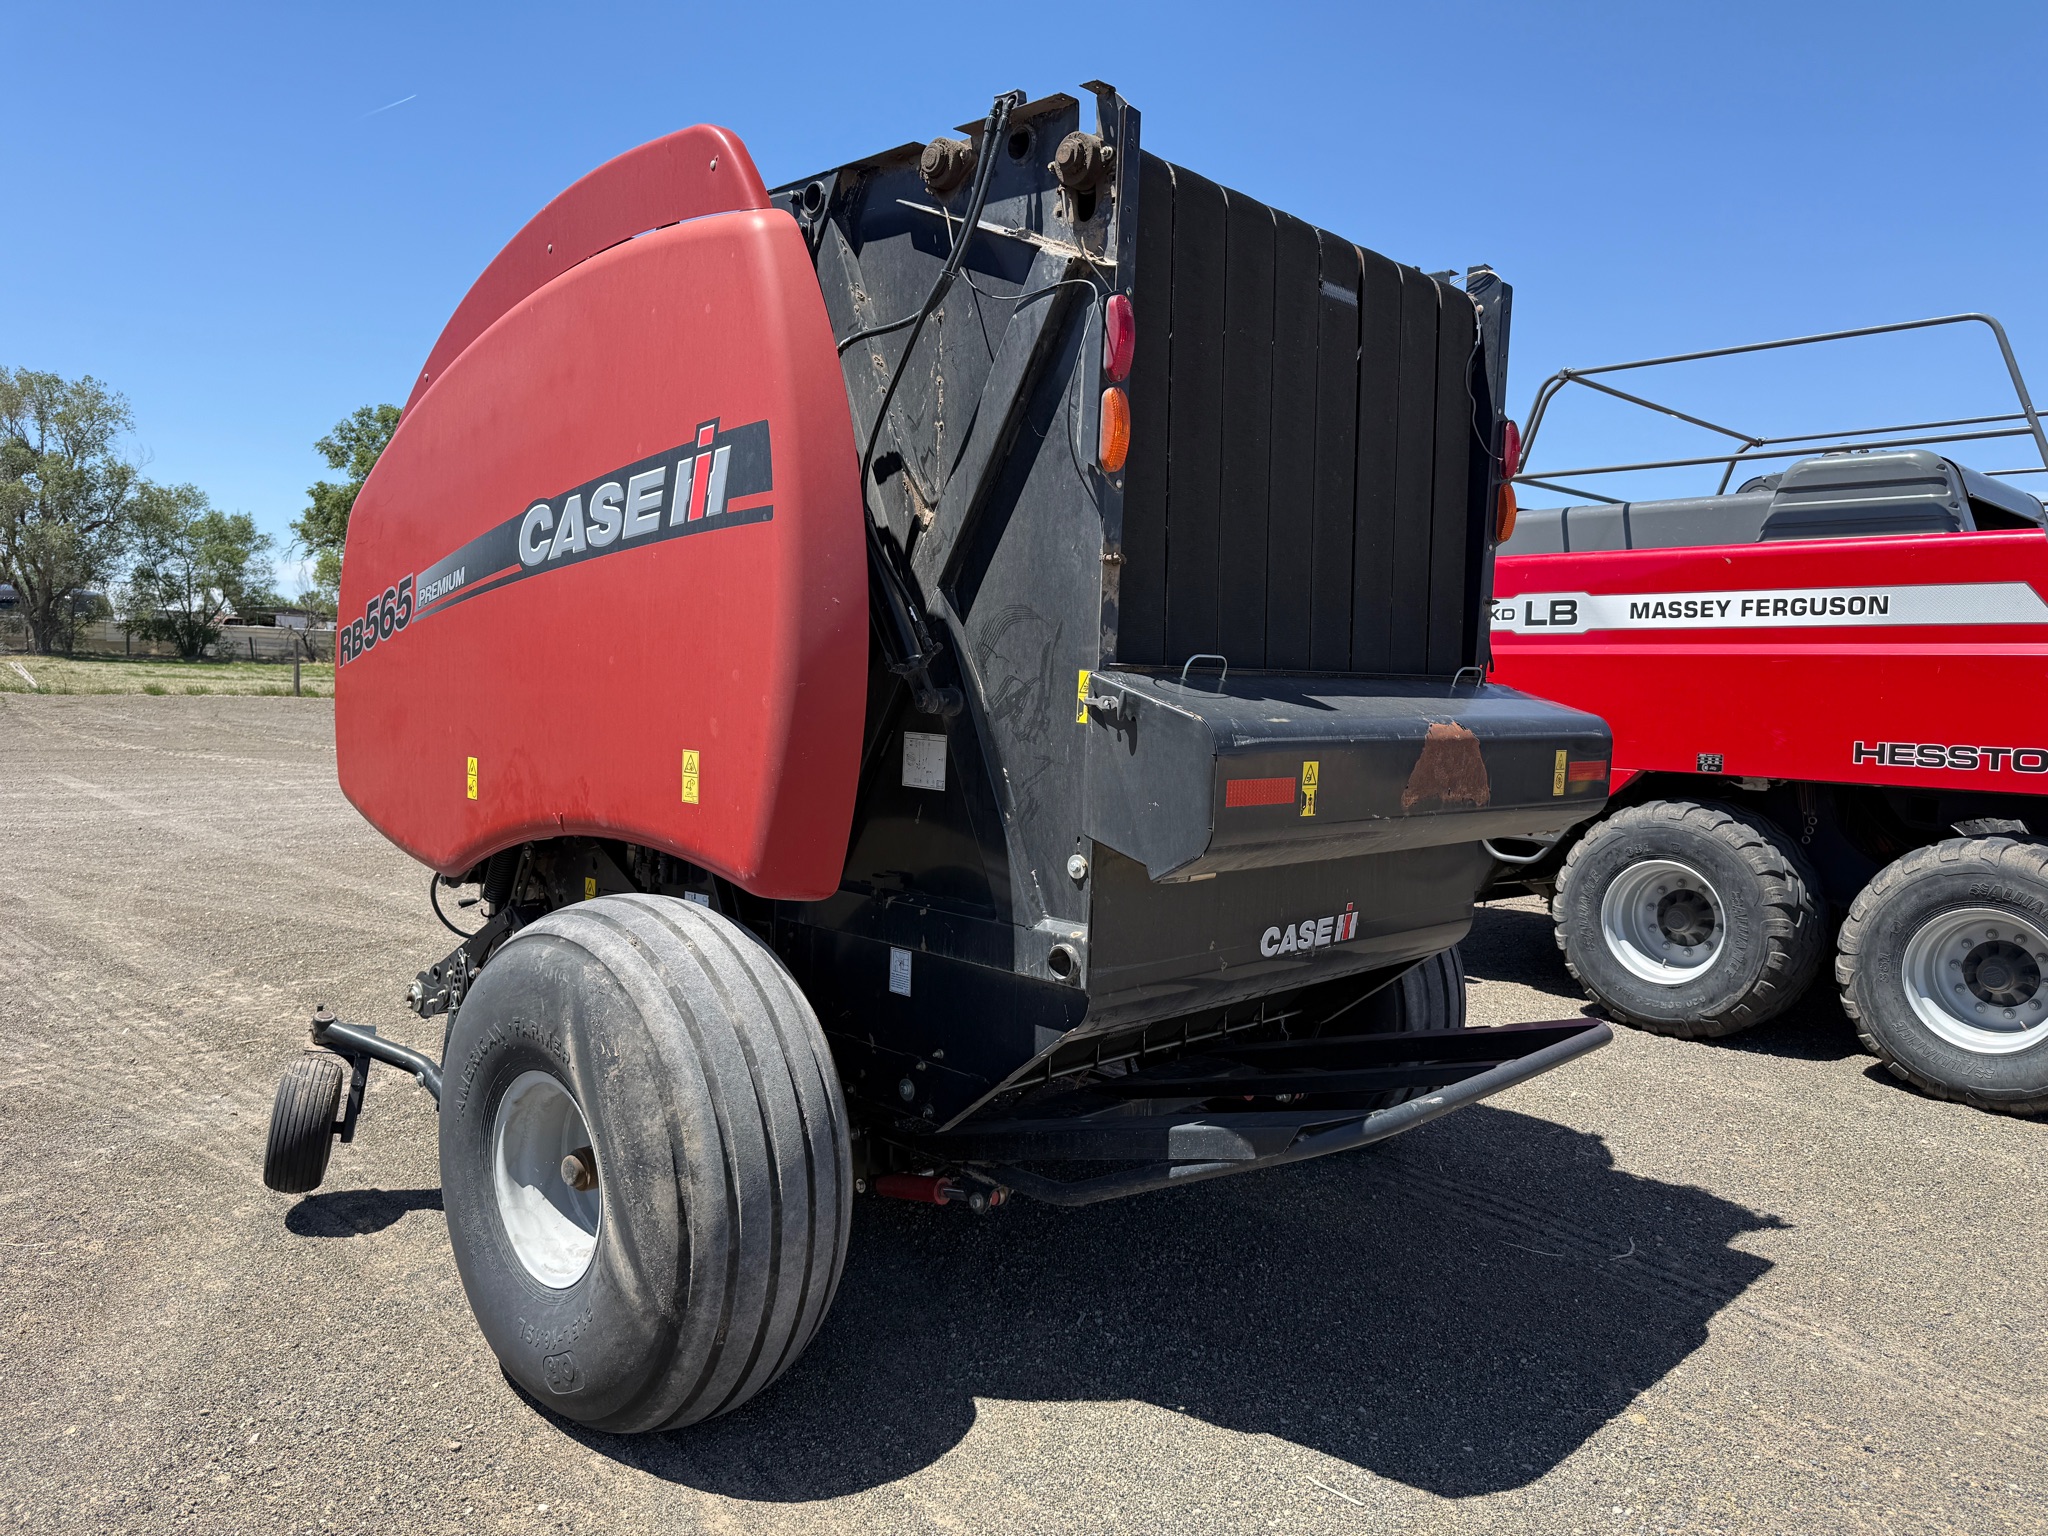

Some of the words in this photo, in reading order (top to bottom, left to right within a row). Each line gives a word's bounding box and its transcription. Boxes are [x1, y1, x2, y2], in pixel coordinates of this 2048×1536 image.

[519, 466, 666, 567] CASE
[418, 567, 465, 607] PREMIUM
[1525, 600, 1577, 626] LB
[1629, 600, 1731, 620] MASSEY
[1740, 595, 1890, 618] FERGUSON
[339, 573, 413, 668] RB565
[1853, 741, 2048, 774] HESSTO
[1579, 869, 1601, 939] ALLIANCE
[1260, 916, 1334, 957] CASE
[1725, 901, 1749, 978] ALLIANCE
[456, 1023, 506, 1117] AMERICAN
[513, 1017, 571, 1070] FARMER
[1892, 1021, 1978, 1076] ALLIANCE
